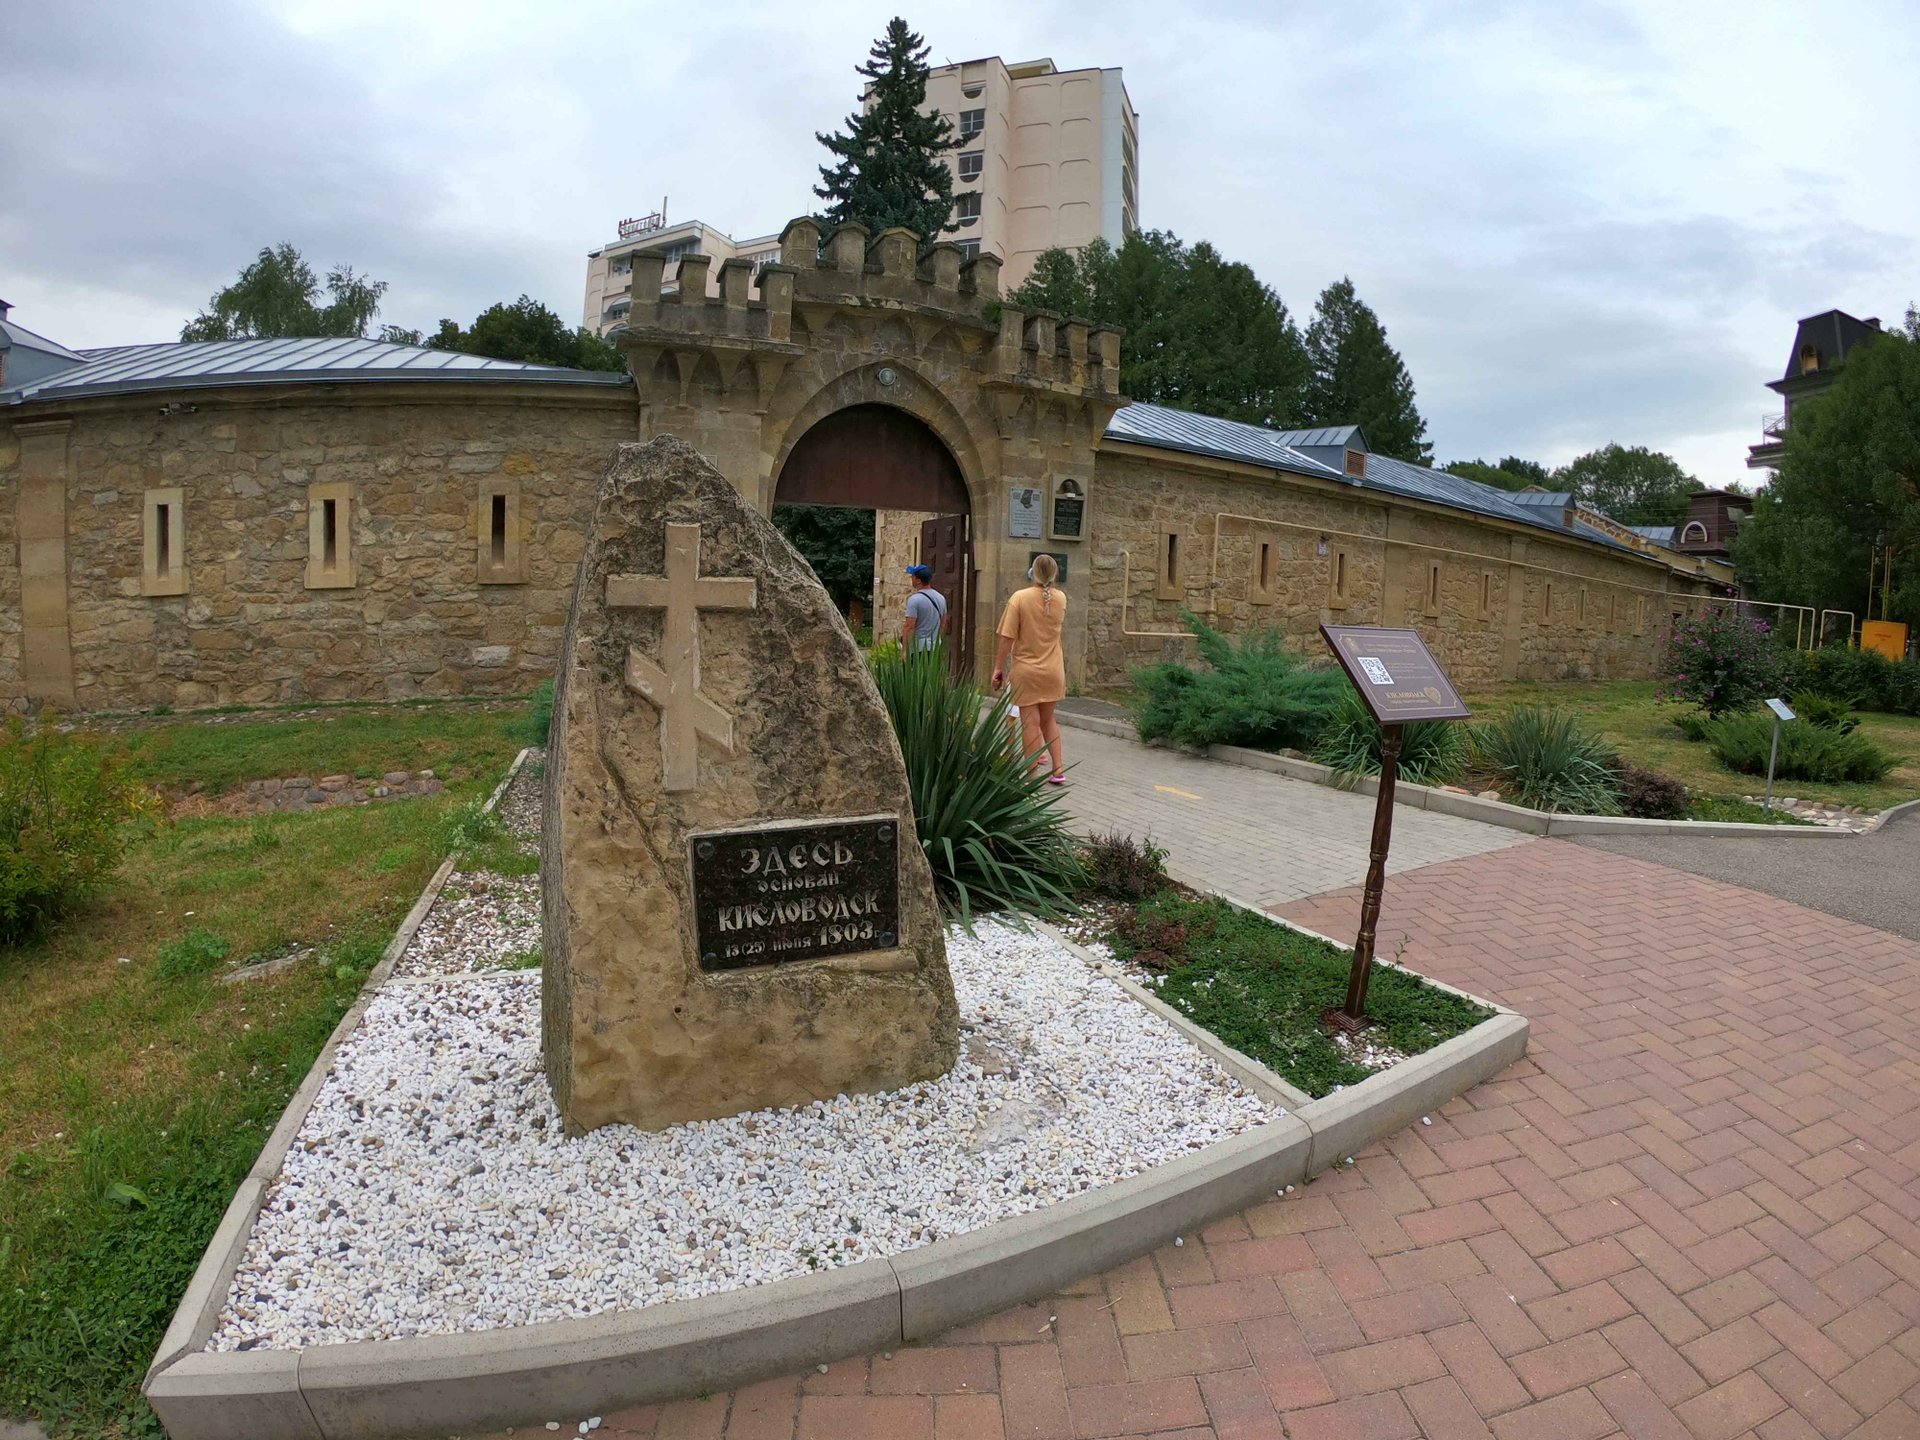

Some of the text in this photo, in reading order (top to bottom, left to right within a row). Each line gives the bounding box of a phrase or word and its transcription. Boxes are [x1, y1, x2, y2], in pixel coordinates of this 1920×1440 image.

[740, 840, 854, 877] ЗДЕСЬ
[757, 871, 840, 893] основан
[718, 889, 881, 932] КИСЛОВОДСК
